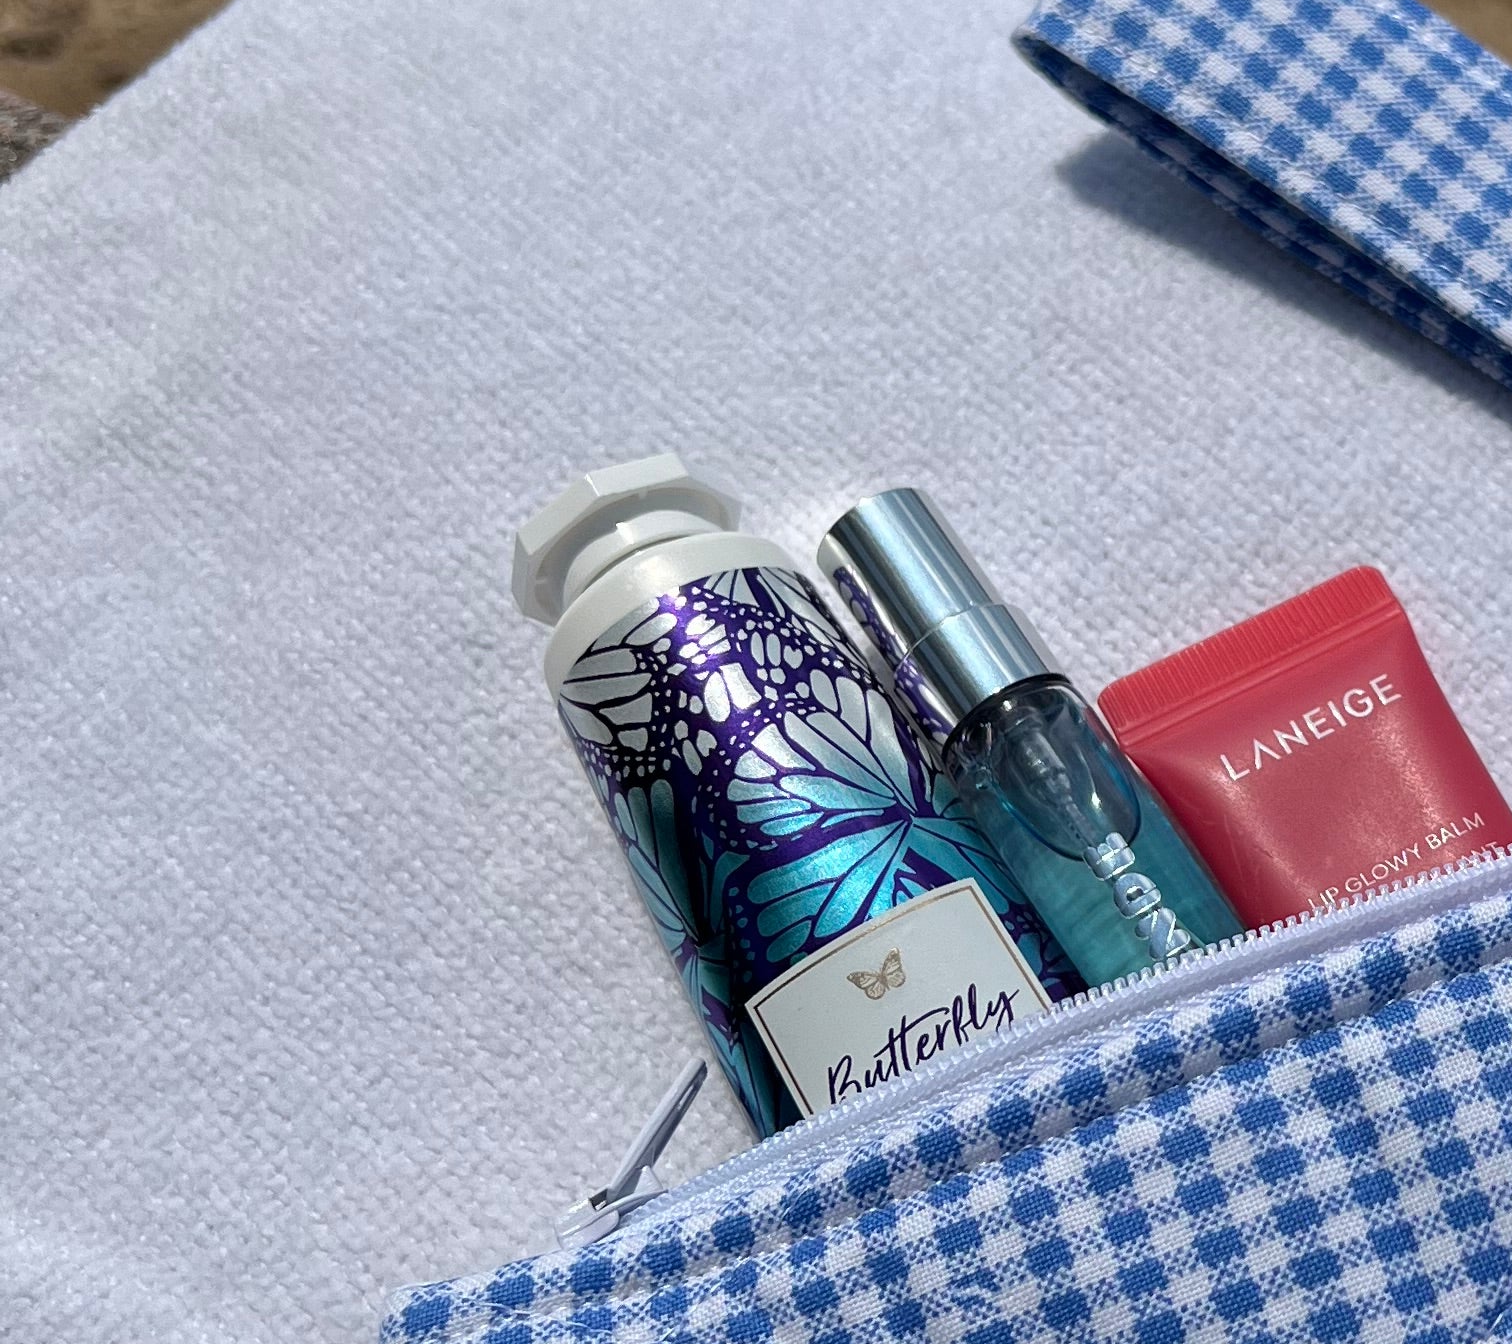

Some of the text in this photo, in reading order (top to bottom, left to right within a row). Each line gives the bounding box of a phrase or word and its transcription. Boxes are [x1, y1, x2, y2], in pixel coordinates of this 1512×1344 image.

[1219, 673, 1402, 782] LANEIGE
[1307, 811, 1486, 912] LIP GLOWY BALM
[826, 982, 1021, 1106] Butterfly
